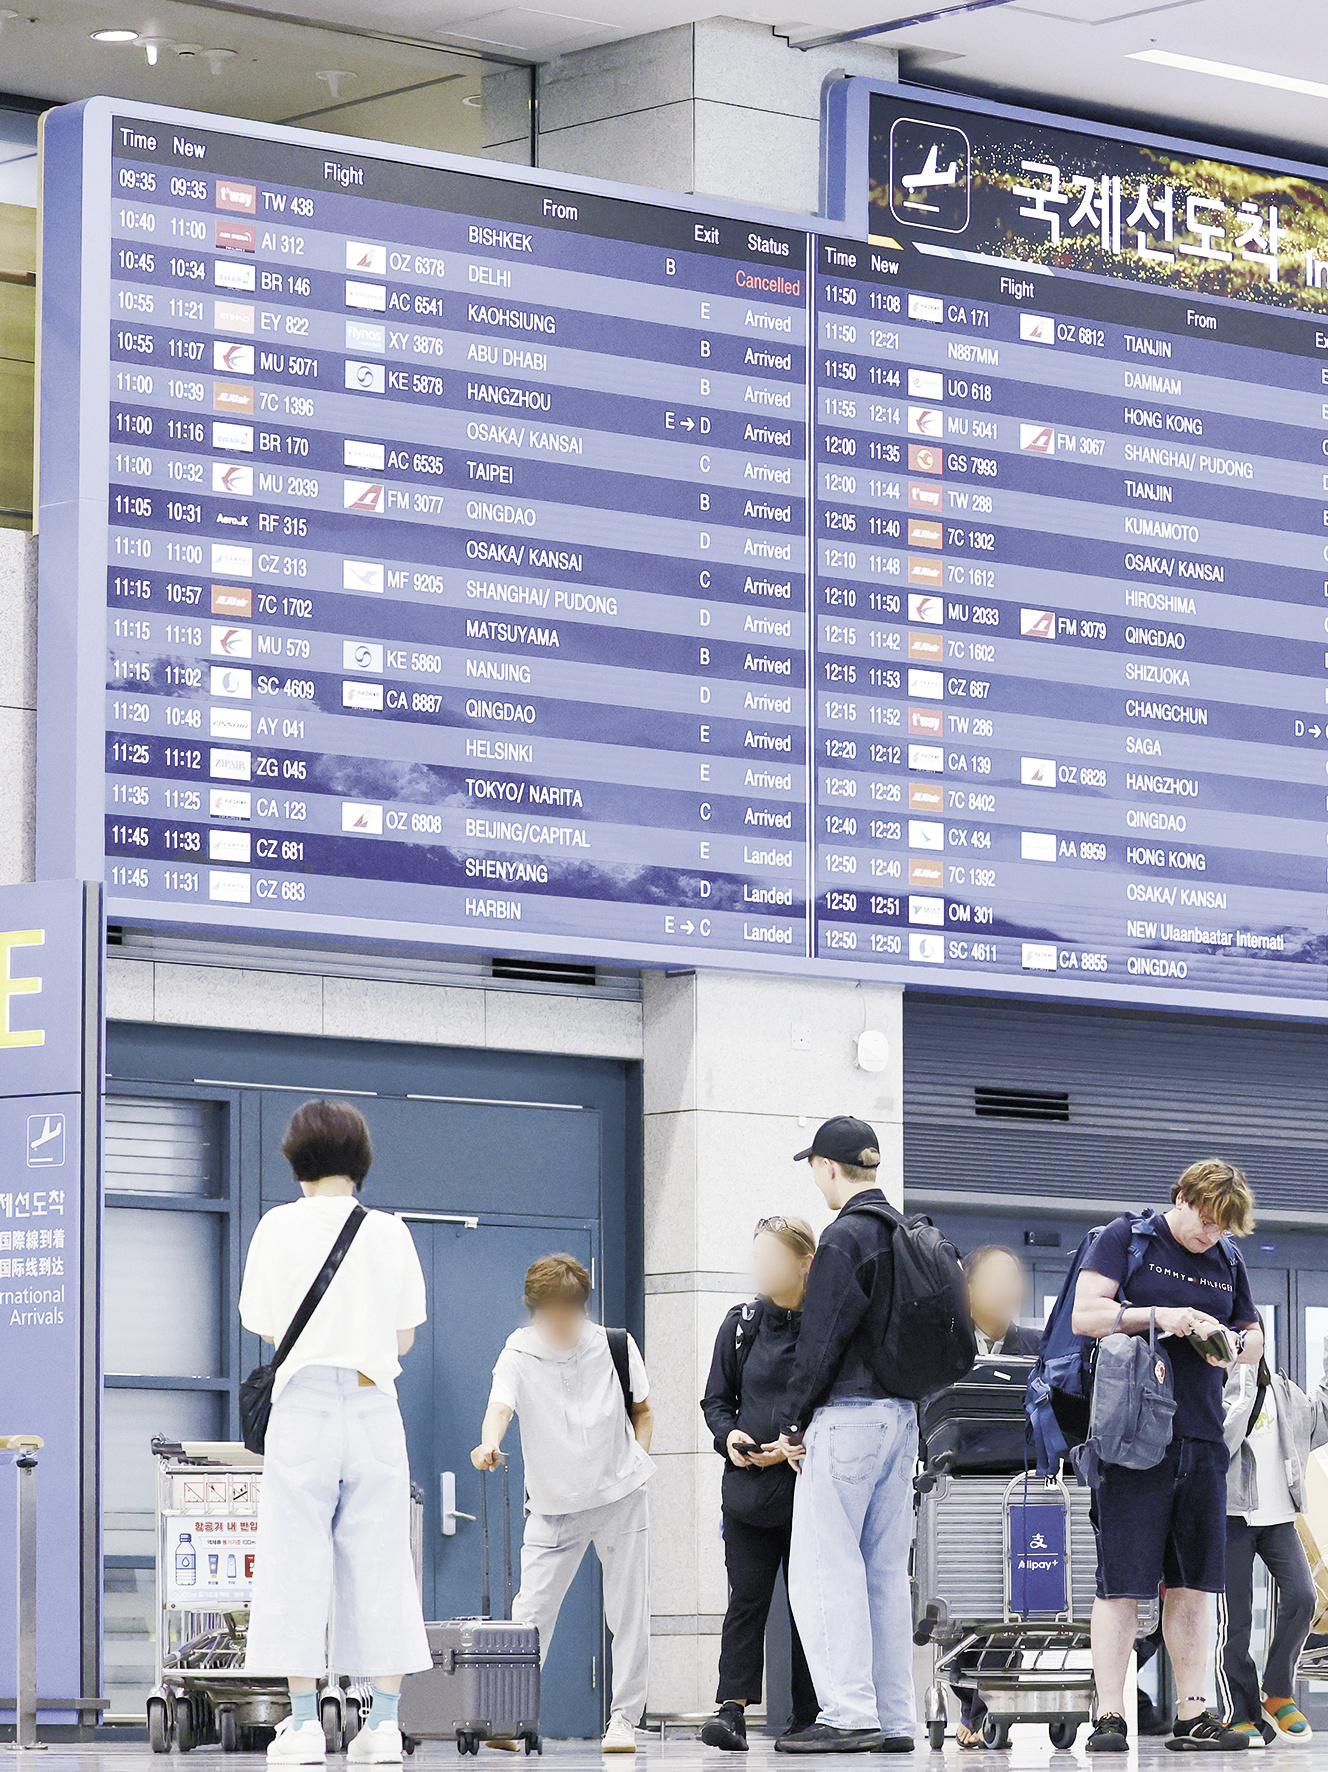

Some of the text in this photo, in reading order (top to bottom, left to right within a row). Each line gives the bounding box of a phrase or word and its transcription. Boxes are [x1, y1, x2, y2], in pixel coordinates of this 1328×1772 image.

[120, 169, 206, 199] 09:35 09:35
[120, 128, 789, 256] Time New Flight From Exit Status
[262, 192, 313, 216] TW 438
[1012, 159, 1287, 283] 국제선도착
[469, 226, 532, 252] BISHKEK
[469, 265, 511, 288] DELHI
[736, 271, 800, 296] Cancelled
[825, 247, 856, 267] Time
[872, 255, 899, 274] New
[1001, 277, 1034, 299] Flight
[1188, 310, 1216, 329] From
[826, 285, 900, 312] 11:50 11:08
[469, 304, 555, 333] KAOHSIUNG
[745, 310, 791, 332] Arrived
[1058, 324, 1104, 346] OZ 6812
[1124, 335, 1171, 357] TIANJIN
[169, 339, 204, 360] 11:07
[467, 344, 547, 371] ABU DHABI
[948, 342, 998, 366] N887MM
[261, 352, 317, 377] MU 5071
[1125, 371, 1181, 395] DAMMAM
[468, 383, 550, 410] HANGZHOU
[1125, 408, 1202, 435] HONG KONG
[467, 422, 582, 454] OSAKA/ KANSAI
[467, 461, 512, 483] TAIPEI
[1125, 444, 1253, 479] SHANGHAI/ PUDONG
[1124, 480, 1172, 502] TIANJIN
[467, 501, 536, 526] QINGDAO
[1125, 517, 1199, 543] KUMAMOTO
[467, 541, 582, 571] OSAKA/ KANSAI
[1125, 554, 1223, 582] OSAKA/ KANSAI
[166, 584, 202, 604] 10:57
[466, 580, 617, 615] SHANGHAI/ PUDONG
[1126, 590, 1197, 615] HIROSHIMA
[467, 620, 559, 647] MATSUYAMA
[1126, 627, 1185, 649] QINGDAO
[467, 659, 530, 683] NANJING
[1126, 663, 1190, 686] SHIZUOKA
[466, 699, 535, 723] QINGDAO
[1126, 700, 1207, 725] CHANGCHUN
[466, 739, 532, 762] HELSINKI
[1126, 736, 1162, 756] SAGA
[466, 779, 582, 807] TOKYO/ NARITA
[1127, 773, 1198, 796] HANGZHOU
[164, 789, 200, 810] 11:25
[466, 819, 590, 847] BEIJING/CAPITAL
[1126, 810, 1186, 832] QINGDAO
[466, 858, 547, 882] SHENYANG
[1127, 847, 1205, 870] HONG KONG
[870, 896, 899, 915] 12:51
[1127, 884, 1226, 909] OSAKA/ KANSAI
[466, 898, 521, 920] HARBIN
[949, 904, 993, 924] OM 301
[744, 922, 792, 943] Landed
[1127, 920, 1284, 950] NEW Ulaanbaatar Internati
[1128, 957, 1187, 978] QINGDAO
[0, 929, 45, 1049] E
[1148, 1263, 1186, 1281] TOMMY
[9, 1306, 64, 1326] Arrivals
